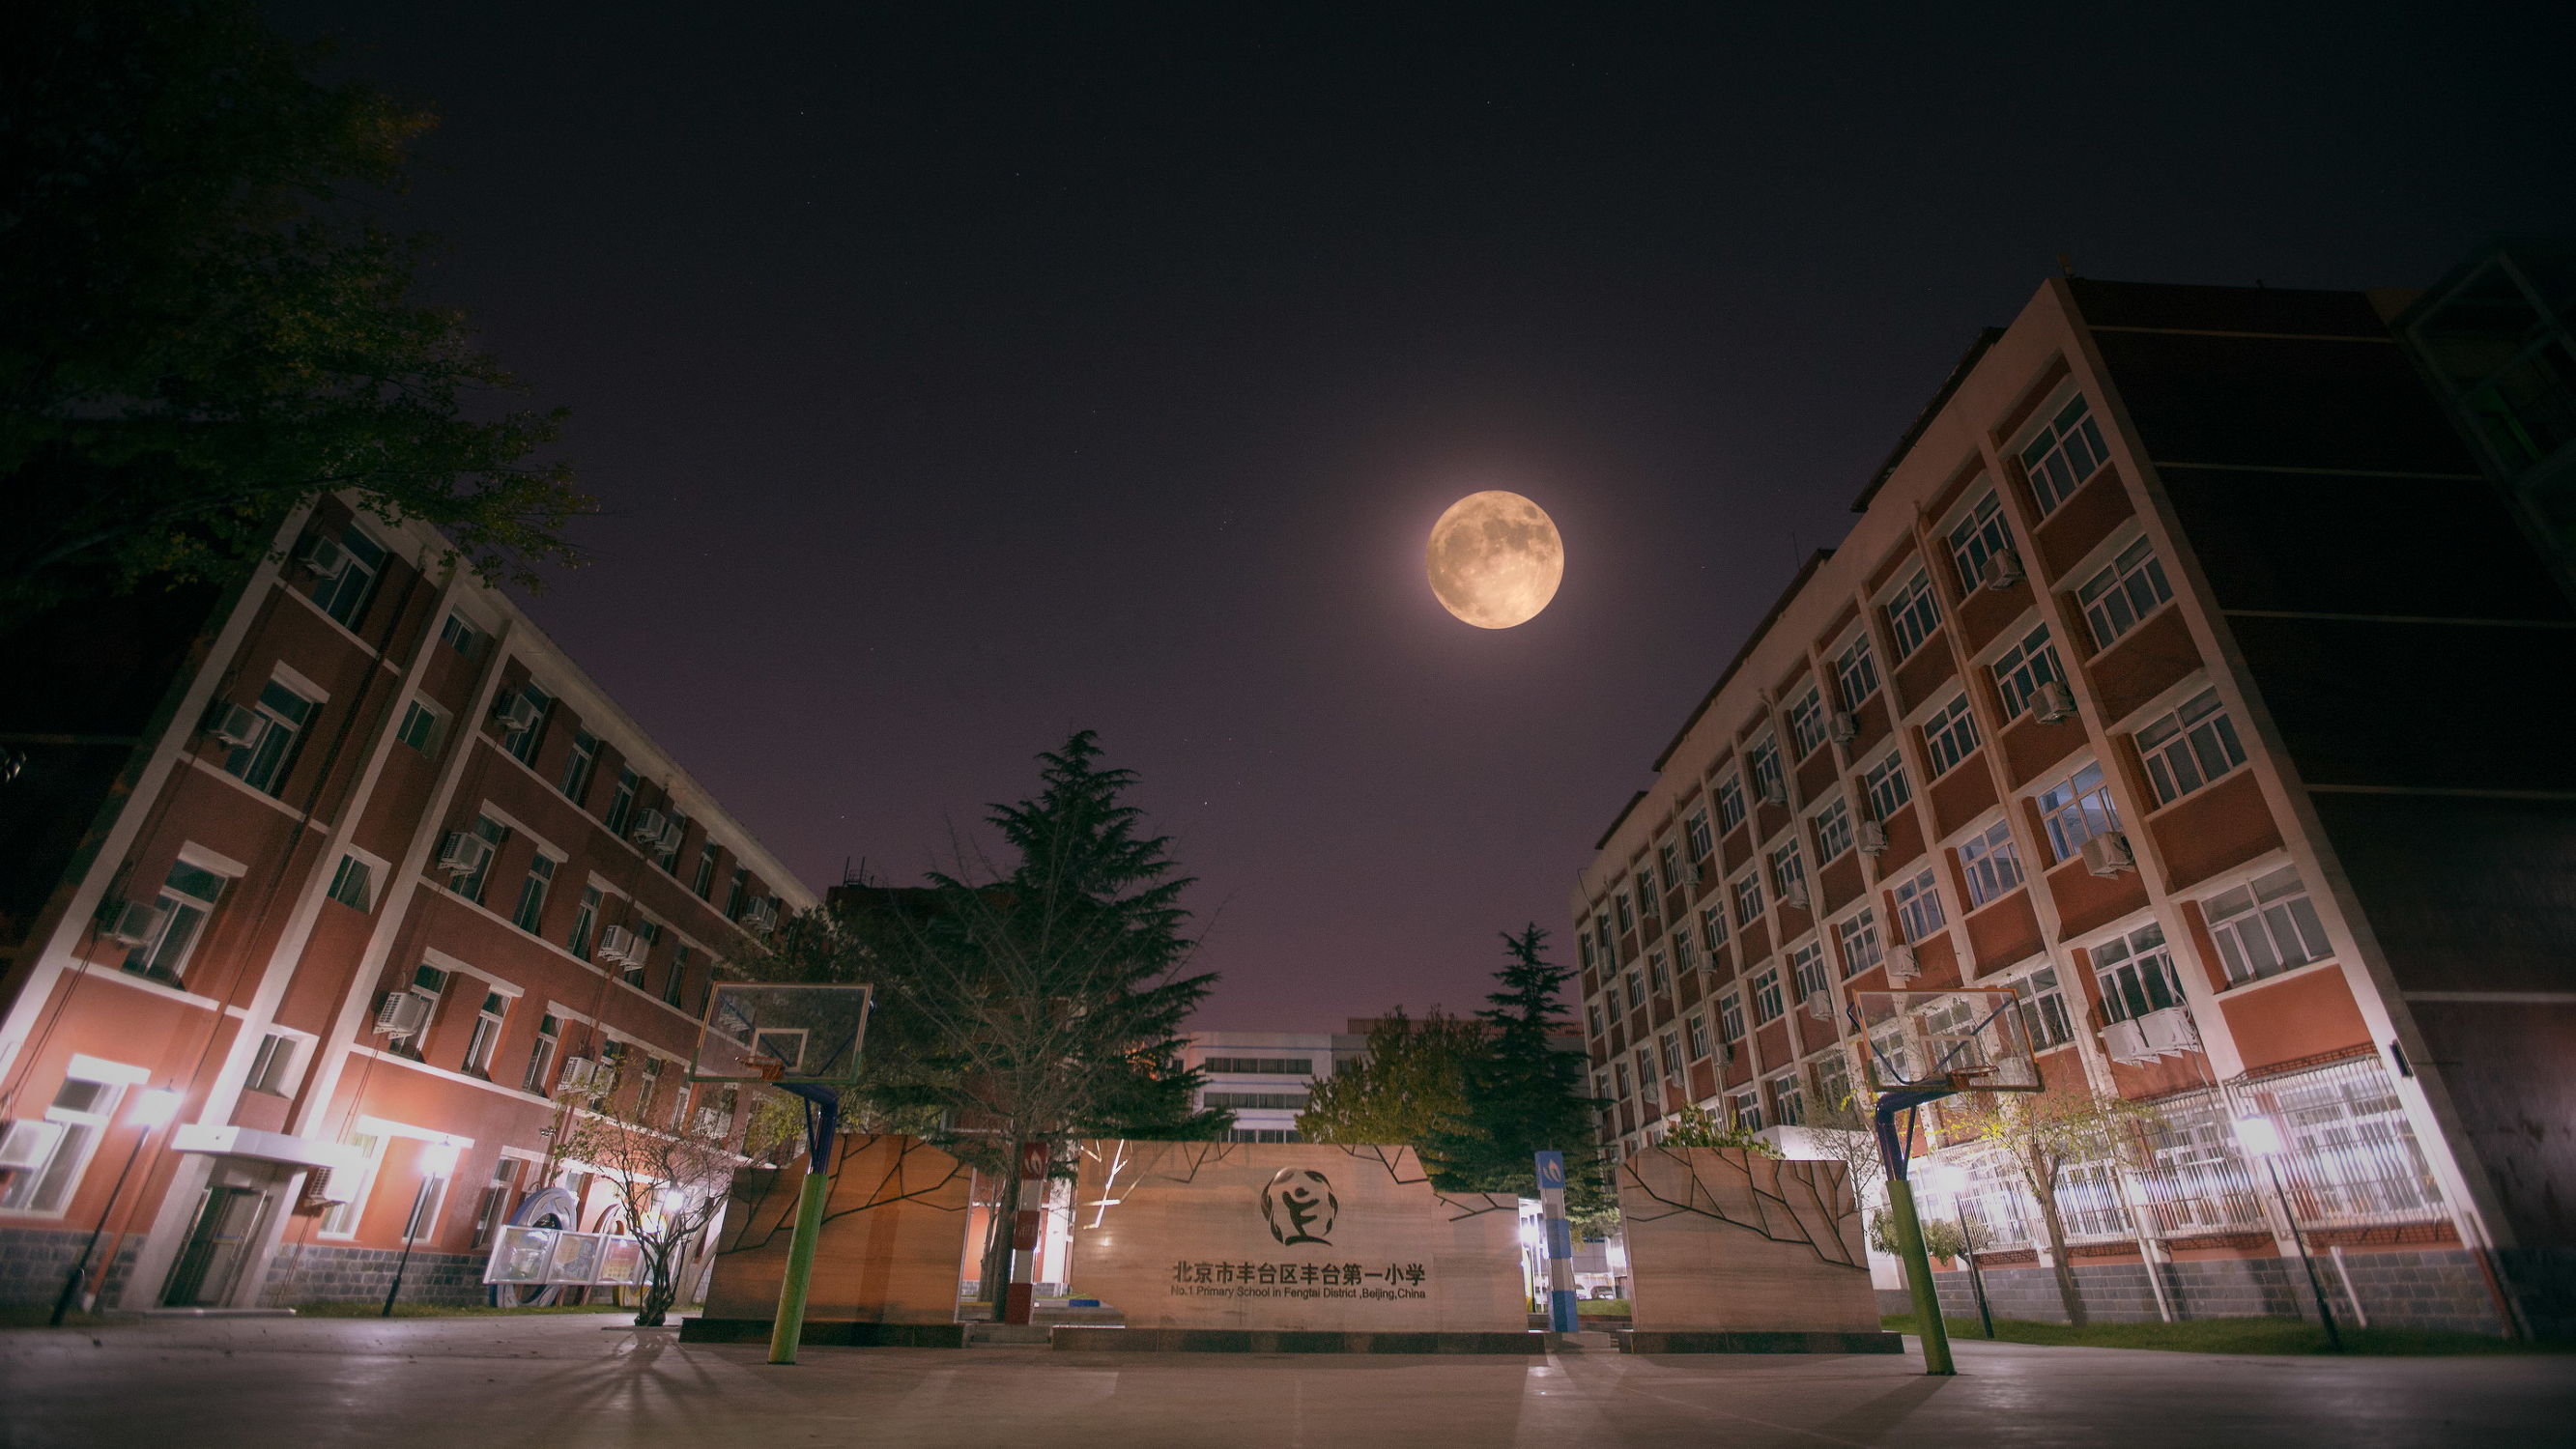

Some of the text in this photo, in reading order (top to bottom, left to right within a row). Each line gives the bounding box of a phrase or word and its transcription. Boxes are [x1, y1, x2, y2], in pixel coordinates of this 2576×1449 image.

[1173, 1261, 1426, 1286] 北京市丰台区丰台第一小学
[1170, 1285, 1193, 1295] No.1
[1196, 1286, 1234, 1298] Primary
[1237, 1286, 1270, 1297] School
[1273, 1286, 1281, 1297] in
[1284, 1287, 1320, 1300] Fengtai
[1323, 1288, 1357, 1298] District
